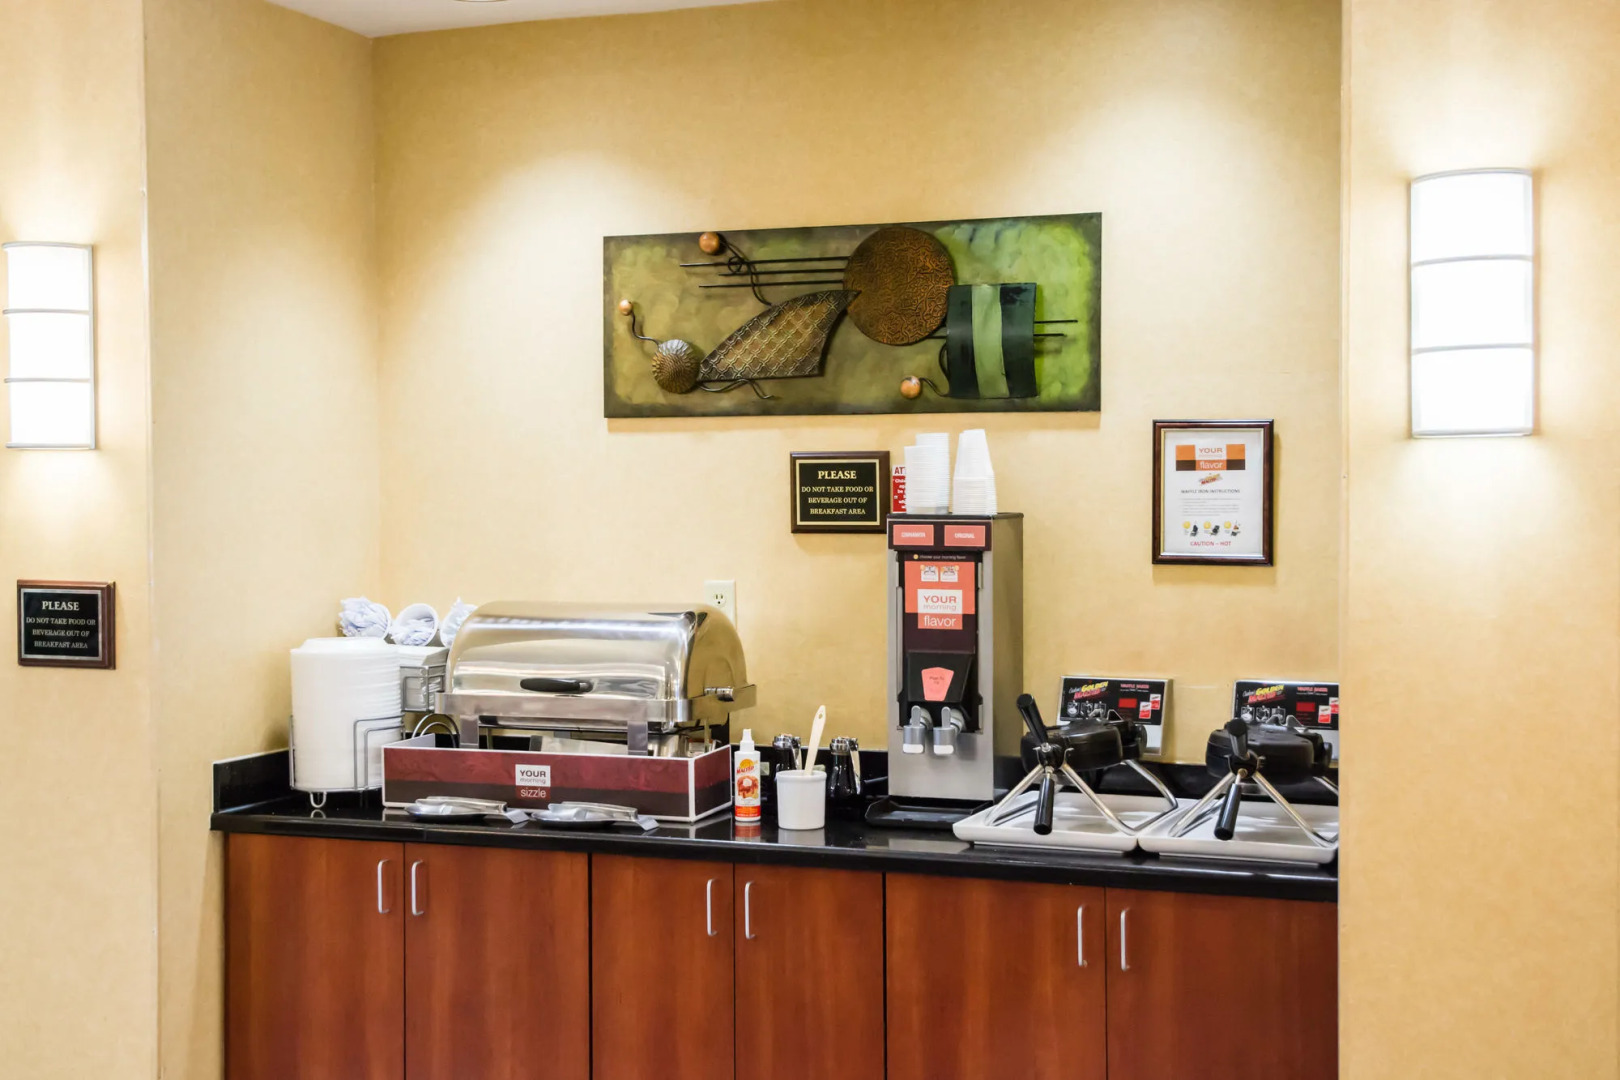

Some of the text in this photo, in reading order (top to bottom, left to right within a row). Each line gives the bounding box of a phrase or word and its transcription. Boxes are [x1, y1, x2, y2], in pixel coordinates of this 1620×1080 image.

[818, 470, 856, 479] PLEASE
[42, 601, 80, 611] PLEASE
[924, 615, 956, 627] flavor
[520, 788, 546, 798] sizzle
